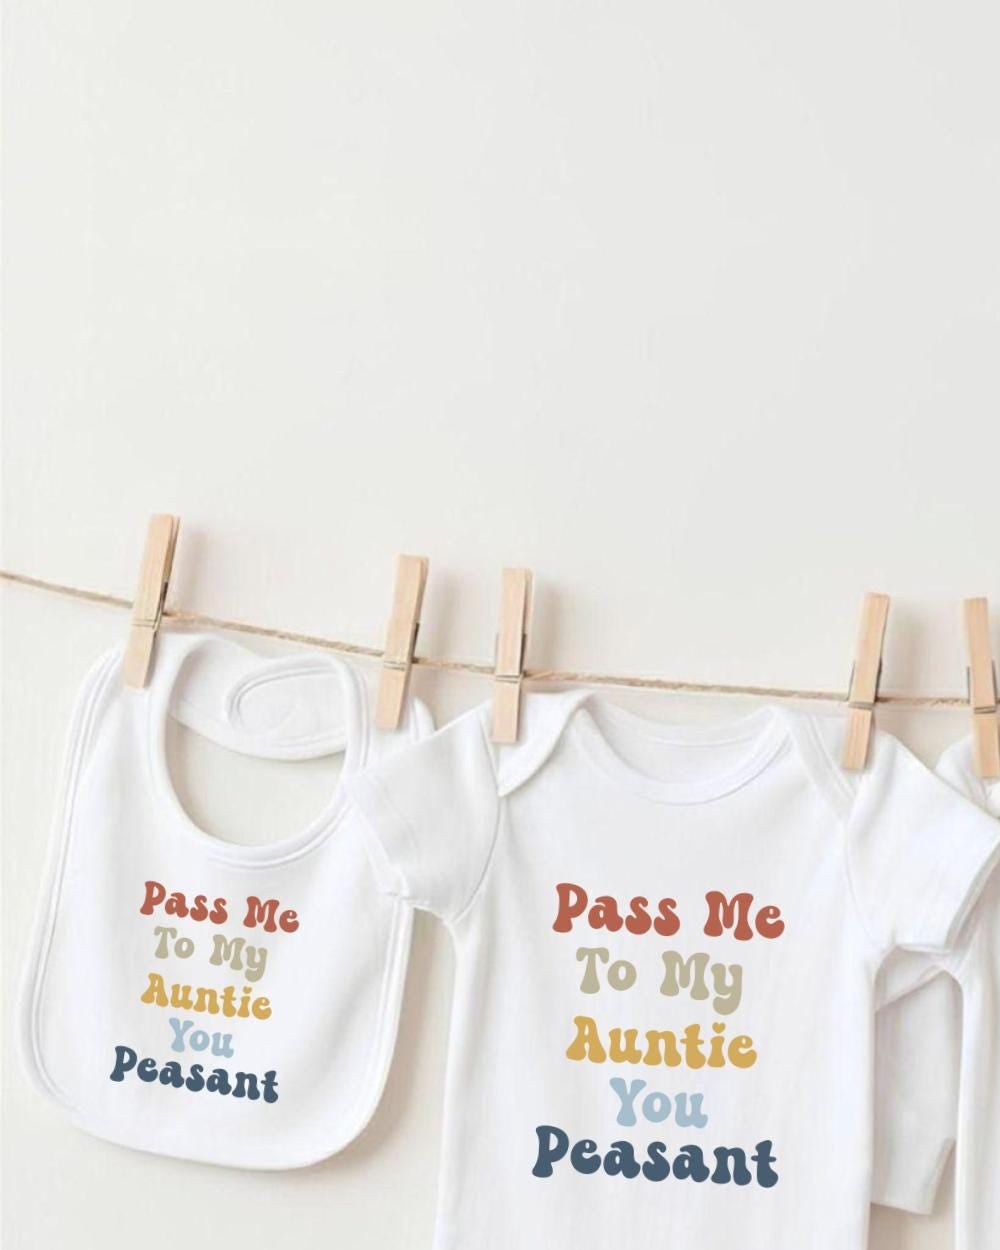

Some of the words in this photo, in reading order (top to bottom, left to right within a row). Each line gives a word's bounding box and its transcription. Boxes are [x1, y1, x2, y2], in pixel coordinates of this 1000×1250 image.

[138, 879, 229, 926] Pass
[242, 895, 301, 934] Me
[551, 882, 682, 938] Pass
[702, 889, 786, 942] Me
[153, 925, 195, 960] To
[209, 934, 268, 983] My
[575, 946, 637, 995] To
[659, 950, 743, 1016] My
[139, 971, 273, 1021] Auntie
[168, 1017, 234, 1059] You
[564, 1014, 758, 1071] Auntie
[109, 1044, 279, 1105] Peasant
[609, 1077, 709, 1129] You
[531, 1124, 780, 1189] Peasant
